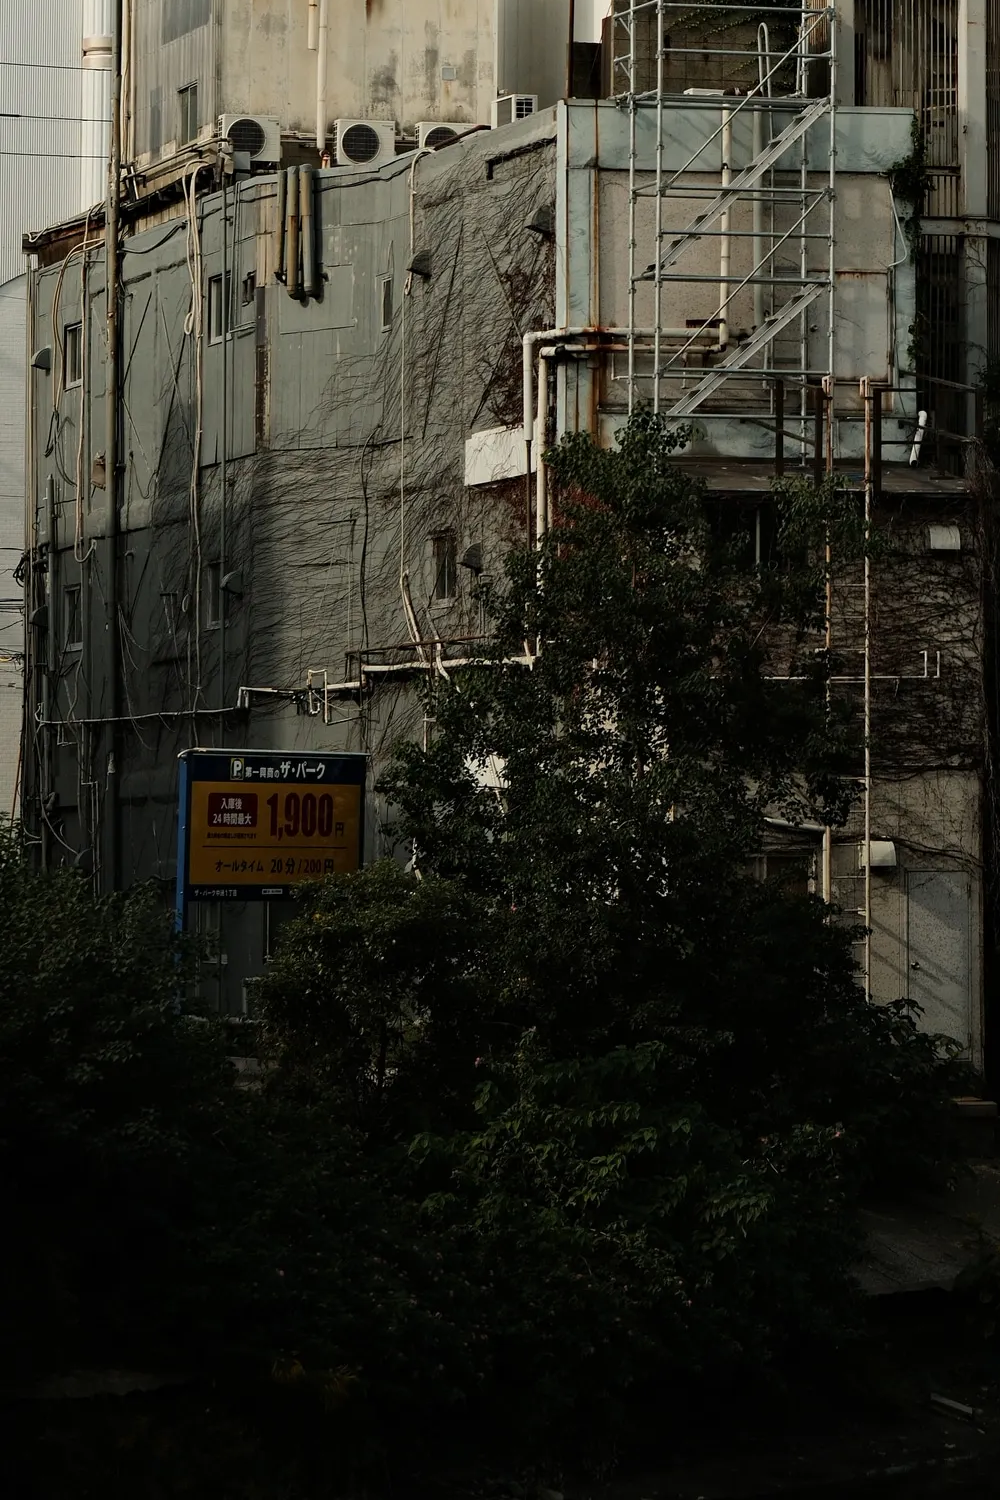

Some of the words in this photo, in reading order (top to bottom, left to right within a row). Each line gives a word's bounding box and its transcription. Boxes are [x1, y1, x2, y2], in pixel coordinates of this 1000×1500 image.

[220, 797, 243, 810] 入庫後
[214, 859, 264, 873] オールタイム
